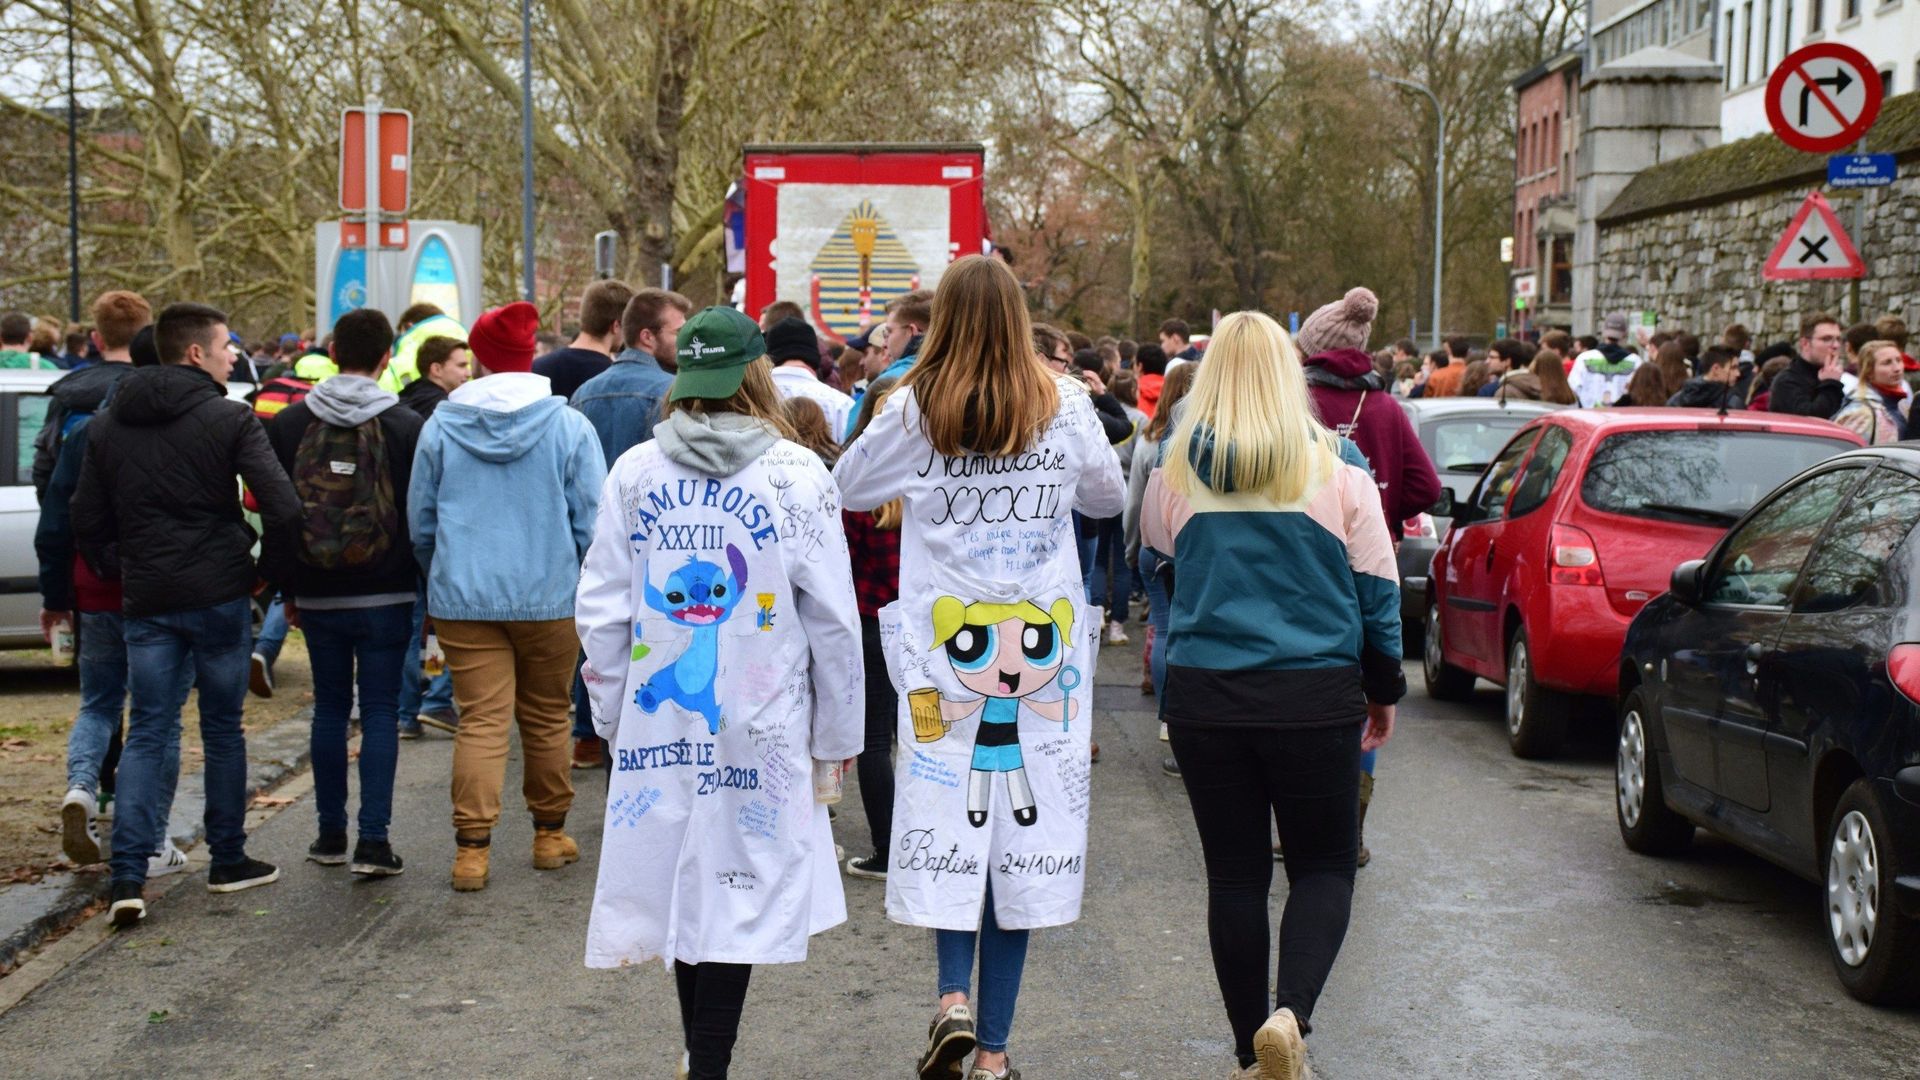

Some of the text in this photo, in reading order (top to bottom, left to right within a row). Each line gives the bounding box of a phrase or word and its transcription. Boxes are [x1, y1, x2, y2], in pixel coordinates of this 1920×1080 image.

[657, 524, 724, 551] XXXIII
[696, 743, 714, 766] LE
[1000, 853, 1081, 876] 24/10/18
